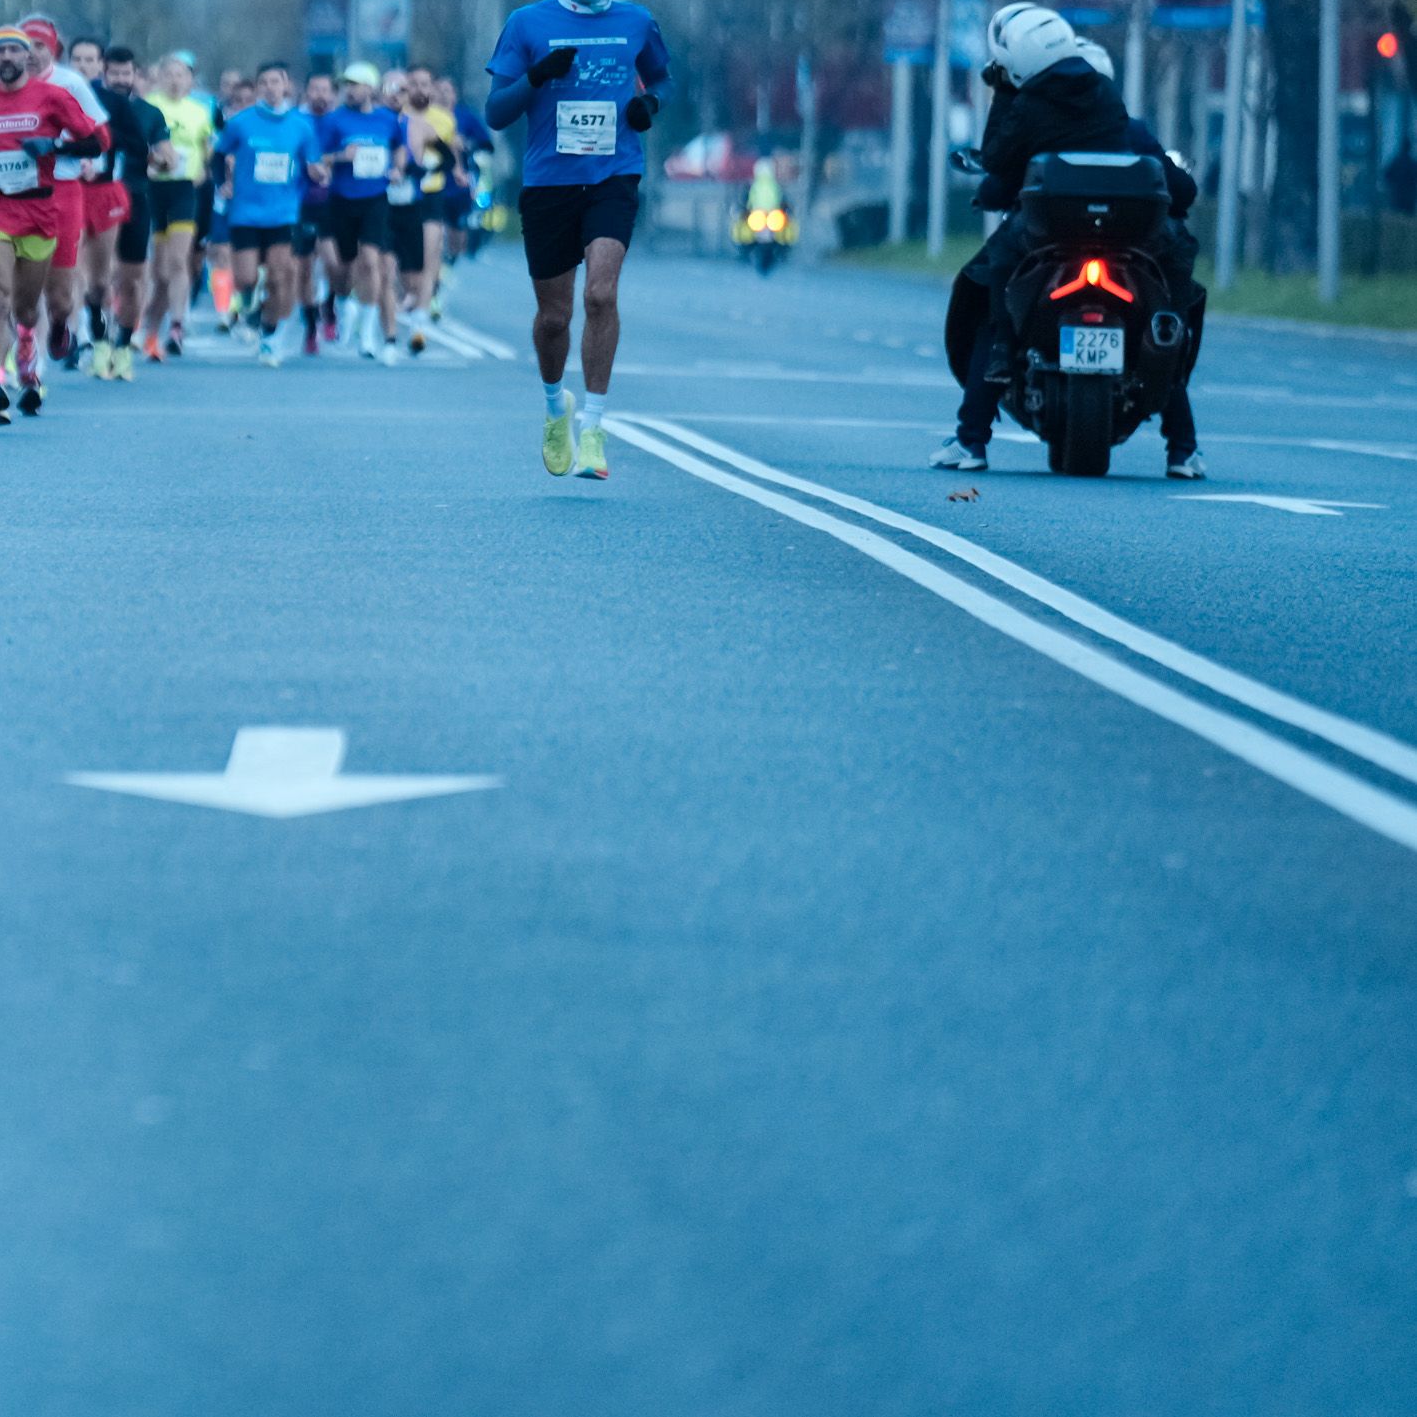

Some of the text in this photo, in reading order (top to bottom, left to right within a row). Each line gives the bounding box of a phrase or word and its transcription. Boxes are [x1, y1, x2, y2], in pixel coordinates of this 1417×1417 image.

[569, 114, 606, 126] 4577
[1076, 331, 1119, 348] 2276
[1075, 350, 1108, 364] KMP
